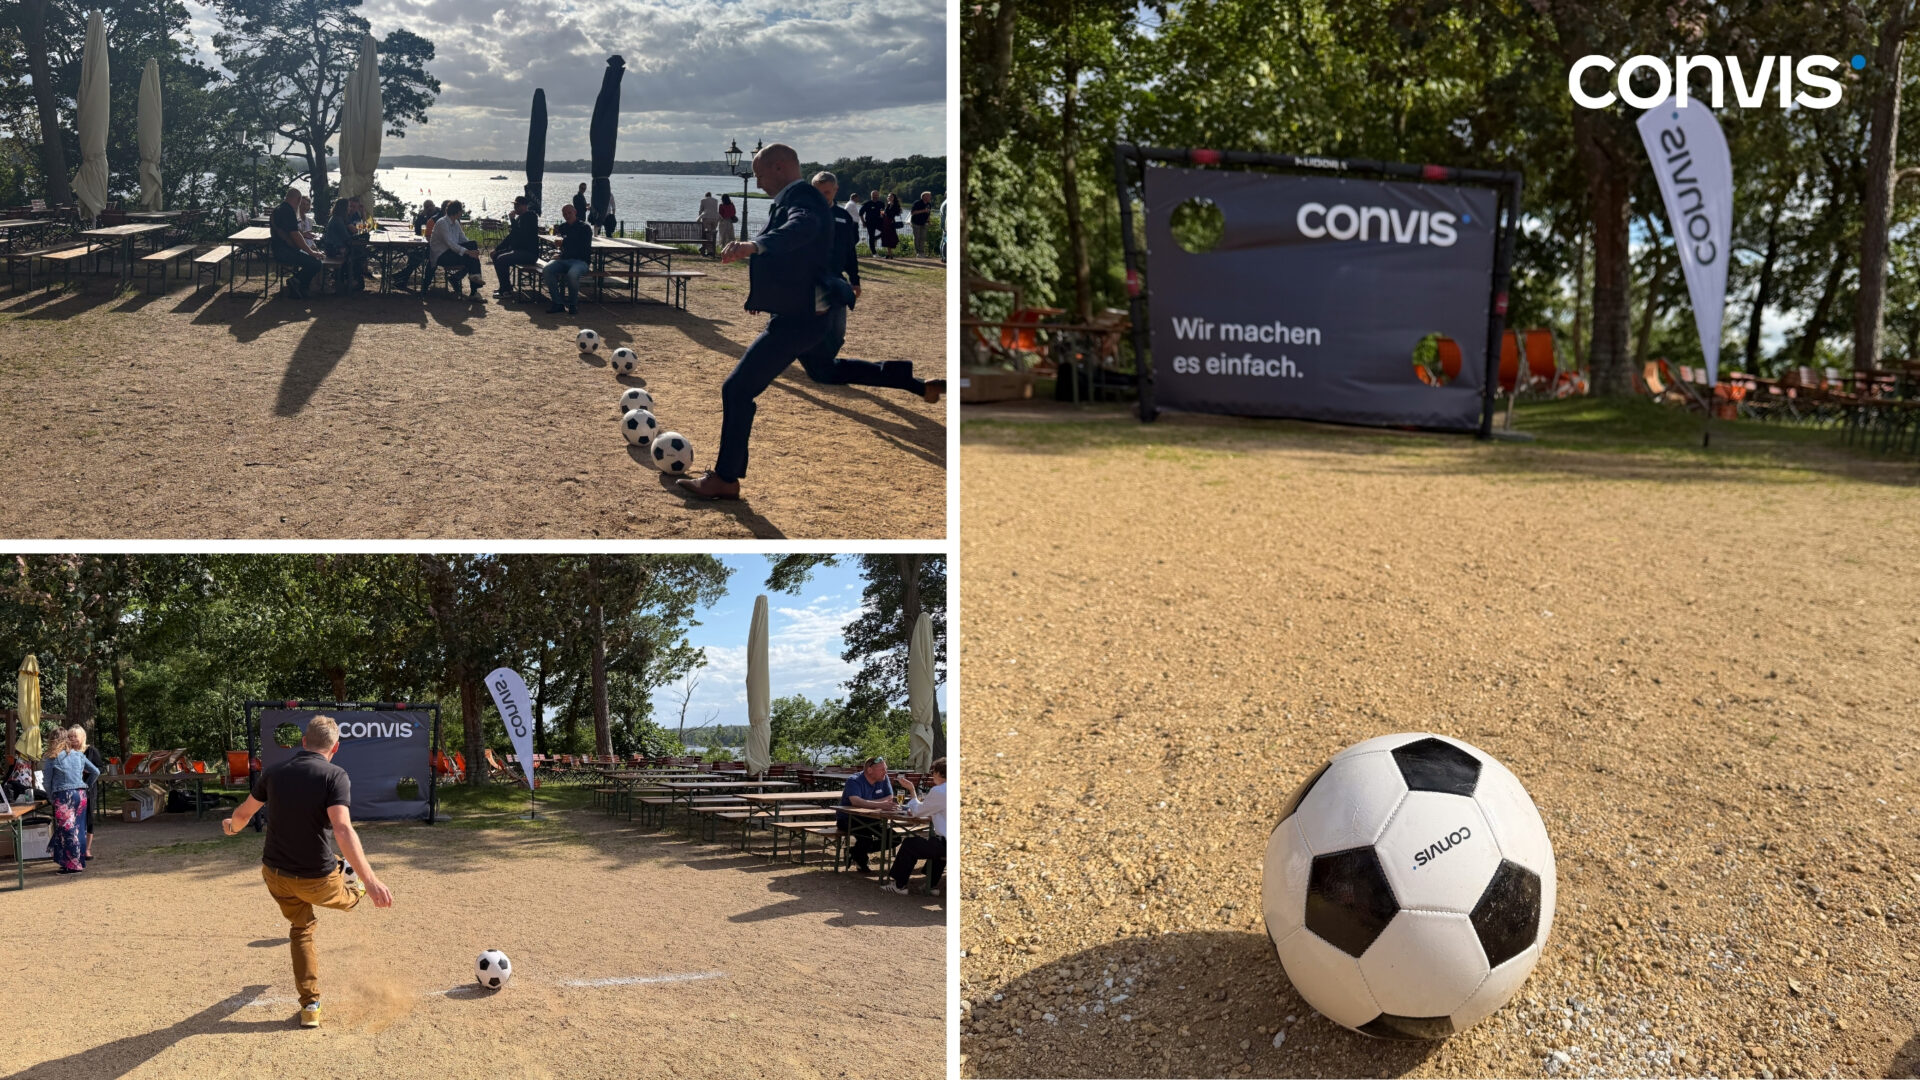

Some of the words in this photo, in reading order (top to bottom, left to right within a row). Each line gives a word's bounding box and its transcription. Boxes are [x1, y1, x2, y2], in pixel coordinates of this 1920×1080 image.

[1171, 317, 1215, 340] Wir
[1219, 321, 1321, 346] machen
[1173, 355, 1200, 374] es
[1205, 353, 1304, 378] einfach.
